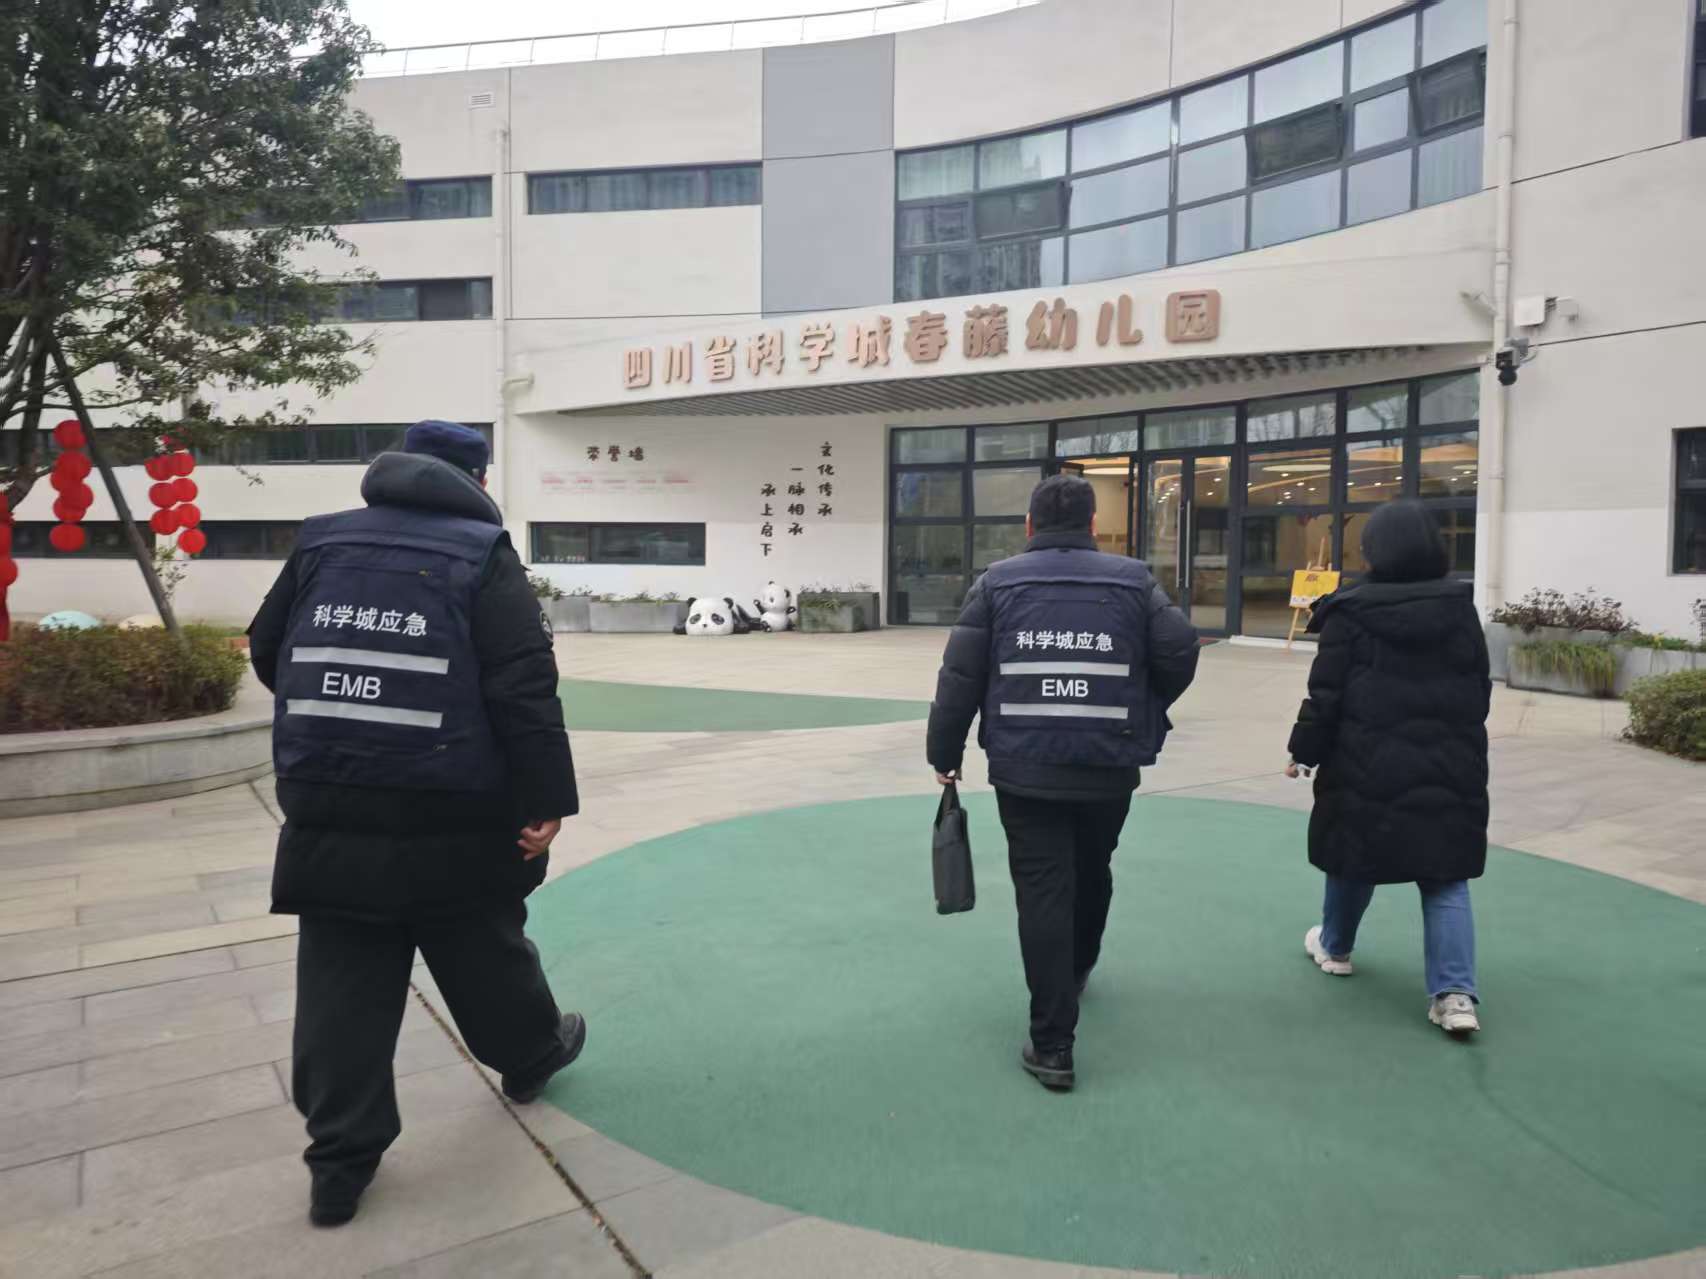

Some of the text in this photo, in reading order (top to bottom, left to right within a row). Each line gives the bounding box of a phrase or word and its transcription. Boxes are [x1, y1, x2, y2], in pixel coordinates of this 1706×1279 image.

[623, 289, 1221, 389] 四川省科学城春藤幼儿园
[787, 466, 805, 536] 一脉相承
[817, 441, 835, 517] 文化传承
[760, 483, 776, 557] 承上启下
[312, 604, 427, 637] 科学城应急
[1016, 630, 1114, 652] 科学城应急
[321, 672, 382, 699] EMB
[1041, 679, 1089, 698] EMB
